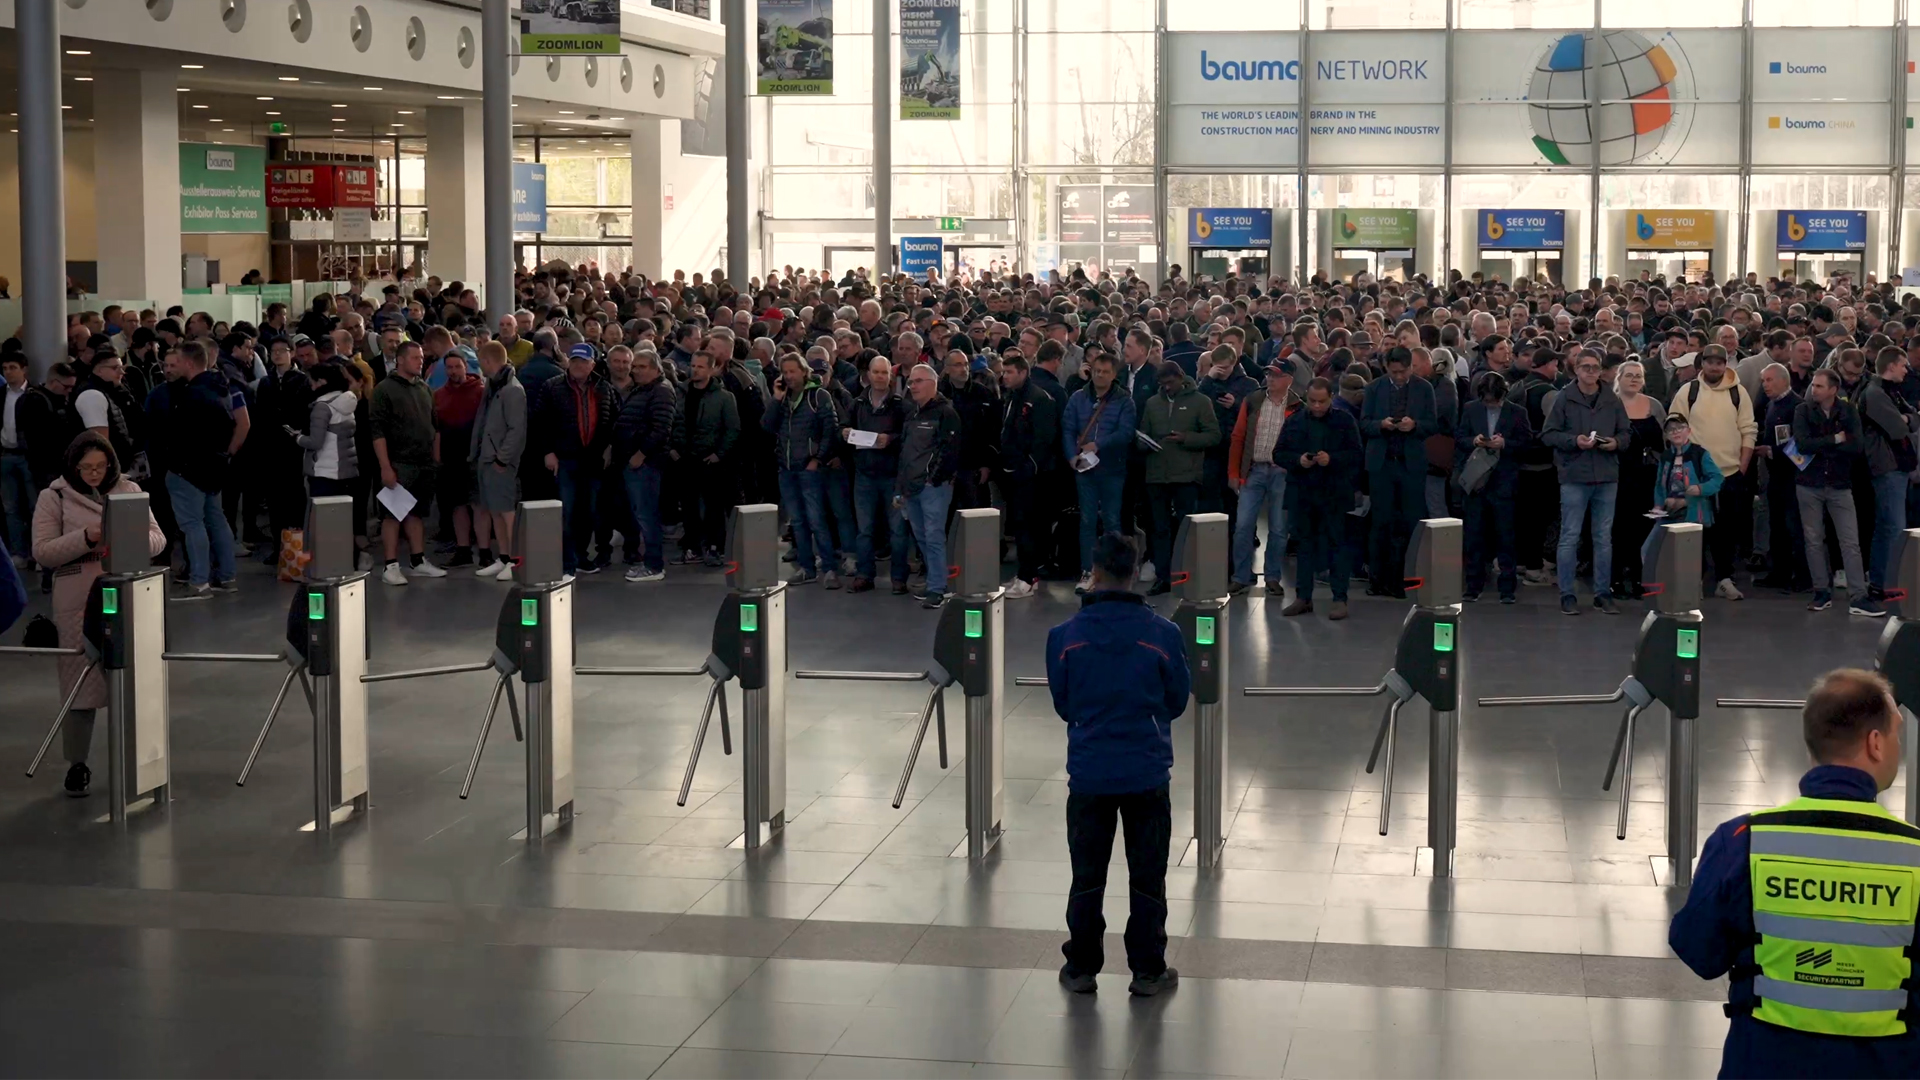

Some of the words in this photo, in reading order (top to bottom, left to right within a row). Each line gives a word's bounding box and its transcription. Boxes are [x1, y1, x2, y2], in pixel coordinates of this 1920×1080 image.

[901, 28, 937, 36] FUTURE
[537, 40, 603, 49] ZOOMLION
[1317, 60, 1428, 80] NETWORK
[1787, 62, 1827, 74] bauma
[769, 84, 820, 92] ZOOMLION
[1201, 111, 1219, 120] THE
[1222, 111, 1262, 120] WORLD'S
[1310, 110, 1343, 120] BRAND
[1345, 110, 1356, 119] IN
[1358, 110, 1377, 119] THE
[1785, 117, 1826, 129] bauma
[1828, 120, 1856, 129] CHINA
[1201, 126, 1272, 135] CONSTRUCTION
[1337, 126, 1357, 135] AND
[1359, 126, 1391, 135] MINING
[1394, 126, 1440, 135] INDUSTRY
[208, 153, 233, 168] bauma
[184, 205, 214, 218] Exhibitor
[215, 206, 230, 218] Pass
[231, 206, 258, 219] Services
[1213, 216, 1231, 225] SEE
[1233, 216, 1252, 225] YOU
[1359, 217, 1376, 226] SEE
[1378, 217, 1398, 226] YOU
[1506, 217, 1524, 226] SEE
[1526, 217, 1546, 226] YOU
[1656, 218, 1674, 226] SEE
[1676, 218, 1695, 226] YOU
[1808, 218, 1827, 228] SEE
[1829, 219, 1849, 228] YOU
[904, 240, 938, 251] bauma
[1765, 876, 1902, 907] SECURITY
